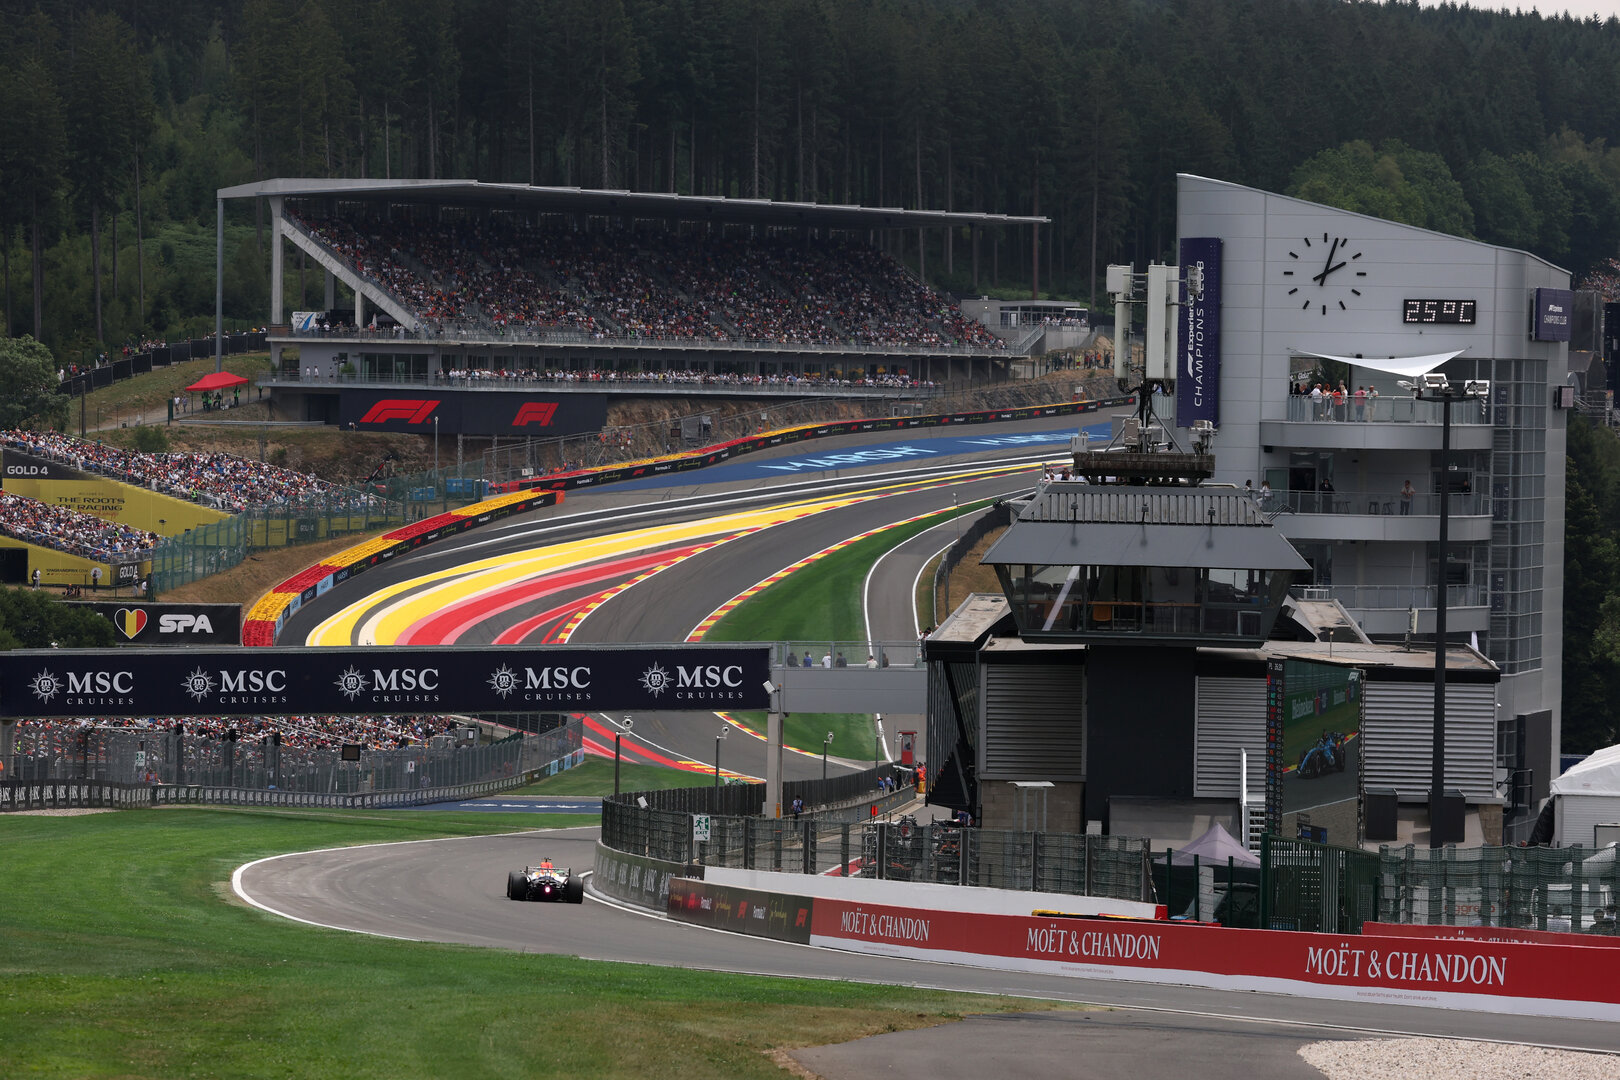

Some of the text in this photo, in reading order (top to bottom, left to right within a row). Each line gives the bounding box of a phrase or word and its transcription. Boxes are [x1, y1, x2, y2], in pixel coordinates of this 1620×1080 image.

[1194, 308, 1204, 407] CHAMPIONS
[7, 465, 49, 476] GOLD 4
[56, 496, 125, 505] THE ROOTS
[77, 504, 123, 512] RACING
[119, 566, 133, 578] GOLD
[159, 614, 214, 634] SPA
[67, 672, 134, 693] MSC
[220, 671, 287, 692] MSC
[373, 669, 439, 690] MSC
[525, 668, 592, 688] MSC
[677, 666, 743, 687] MSC
[220, 696, 287, 704] CRUISES
[373, 695, 439, 703] CRUISES
[525, 693, 592, 701] CRUISES
[840, 908, 931, 941] MOËT & CHANDON
[1026, 924, 1161, 960] MOËT & CHANDON
[1305, 942, 1508, 986] MOËT & CHANDON
